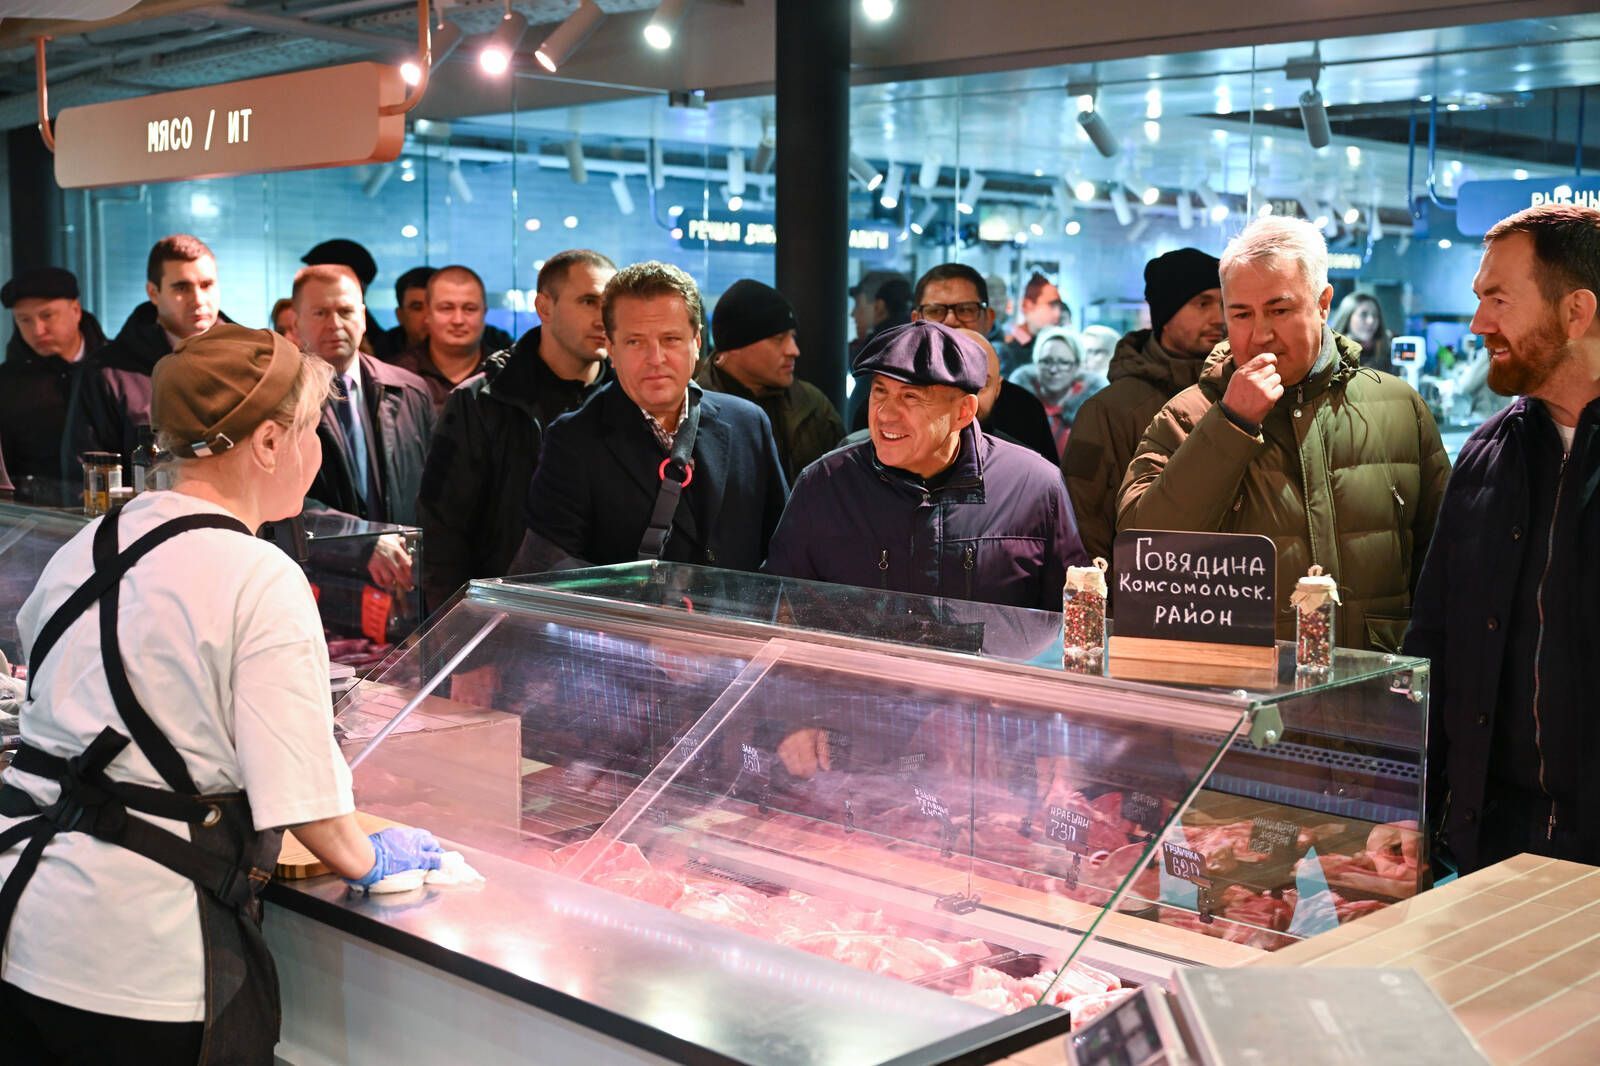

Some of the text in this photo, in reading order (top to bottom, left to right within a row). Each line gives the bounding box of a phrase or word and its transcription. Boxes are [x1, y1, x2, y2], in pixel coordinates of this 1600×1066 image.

[147, 108, 252, 153] МЯСО / ИТ
[1155, 602, 1232, 626] РАЙОН
